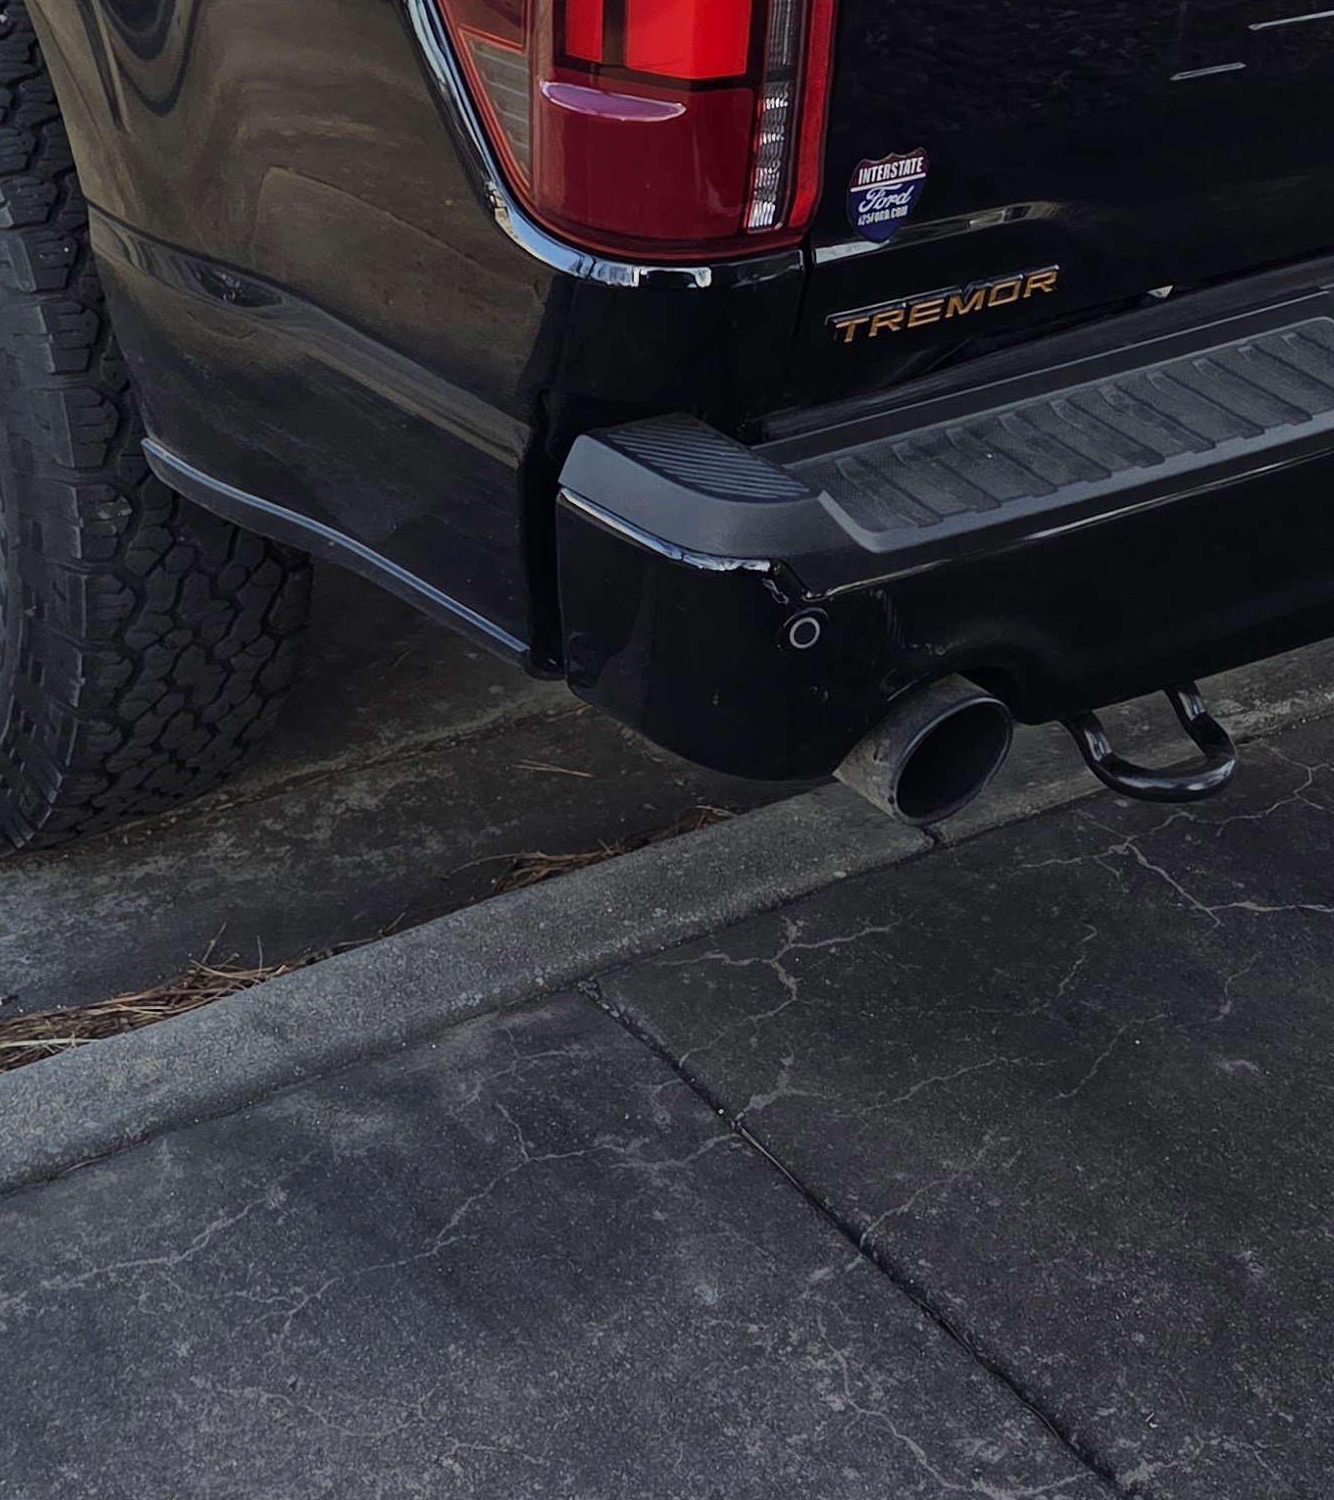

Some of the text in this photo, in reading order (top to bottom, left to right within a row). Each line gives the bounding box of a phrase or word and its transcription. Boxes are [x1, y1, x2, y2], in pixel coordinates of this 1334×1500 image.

[858, 156, 925, 186] INTERSTATE
[858, 183, 915, 213] Ford
[833, 264, 1061, 344] TREMOR
